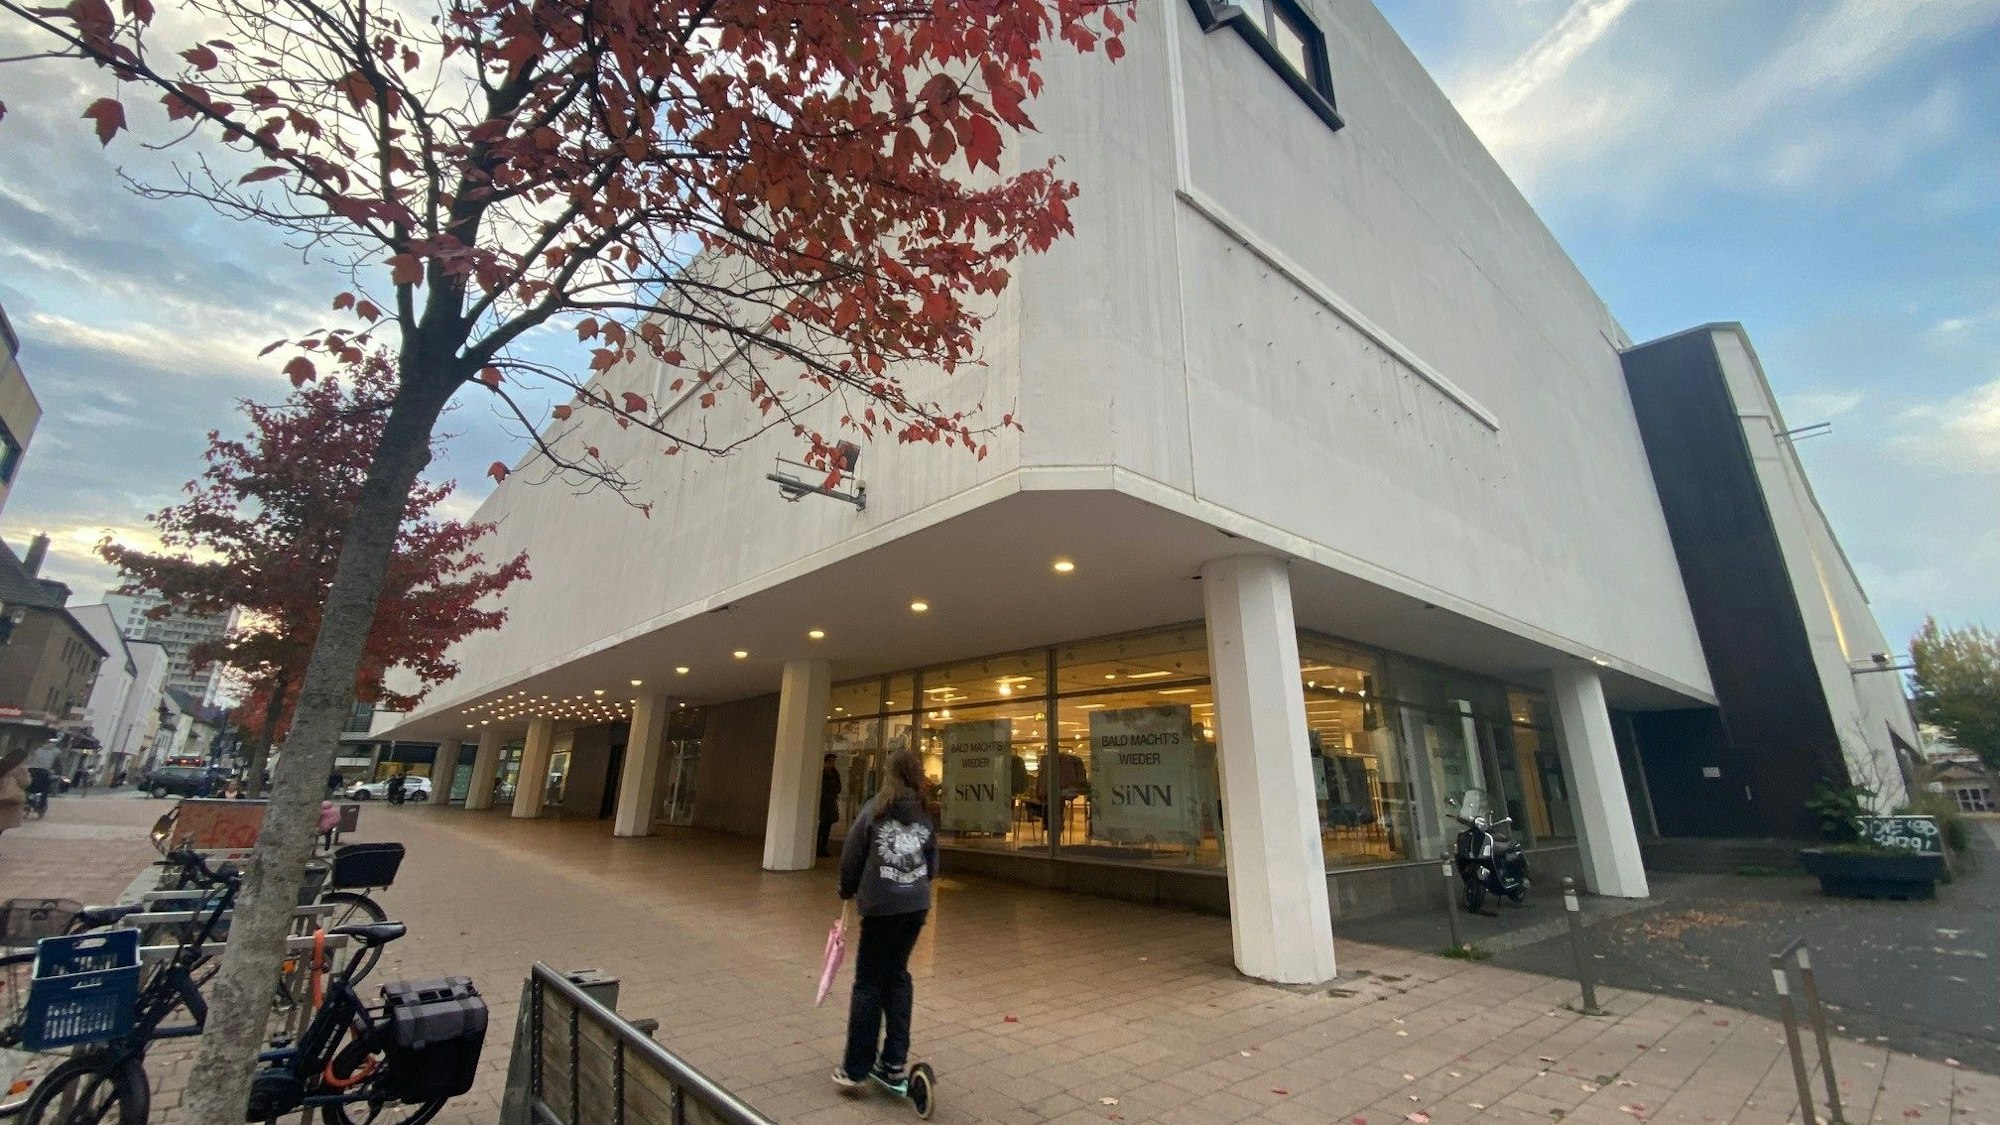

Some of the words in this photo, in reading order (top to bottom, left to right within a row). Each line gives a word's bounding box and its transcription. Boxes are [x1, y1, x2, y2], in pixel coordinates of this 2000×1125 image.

[1101, 734, 1128, 748] BALD
[951, 743, 969, 753] BALD
[1119, 753, 1161, 766] WIEDER
